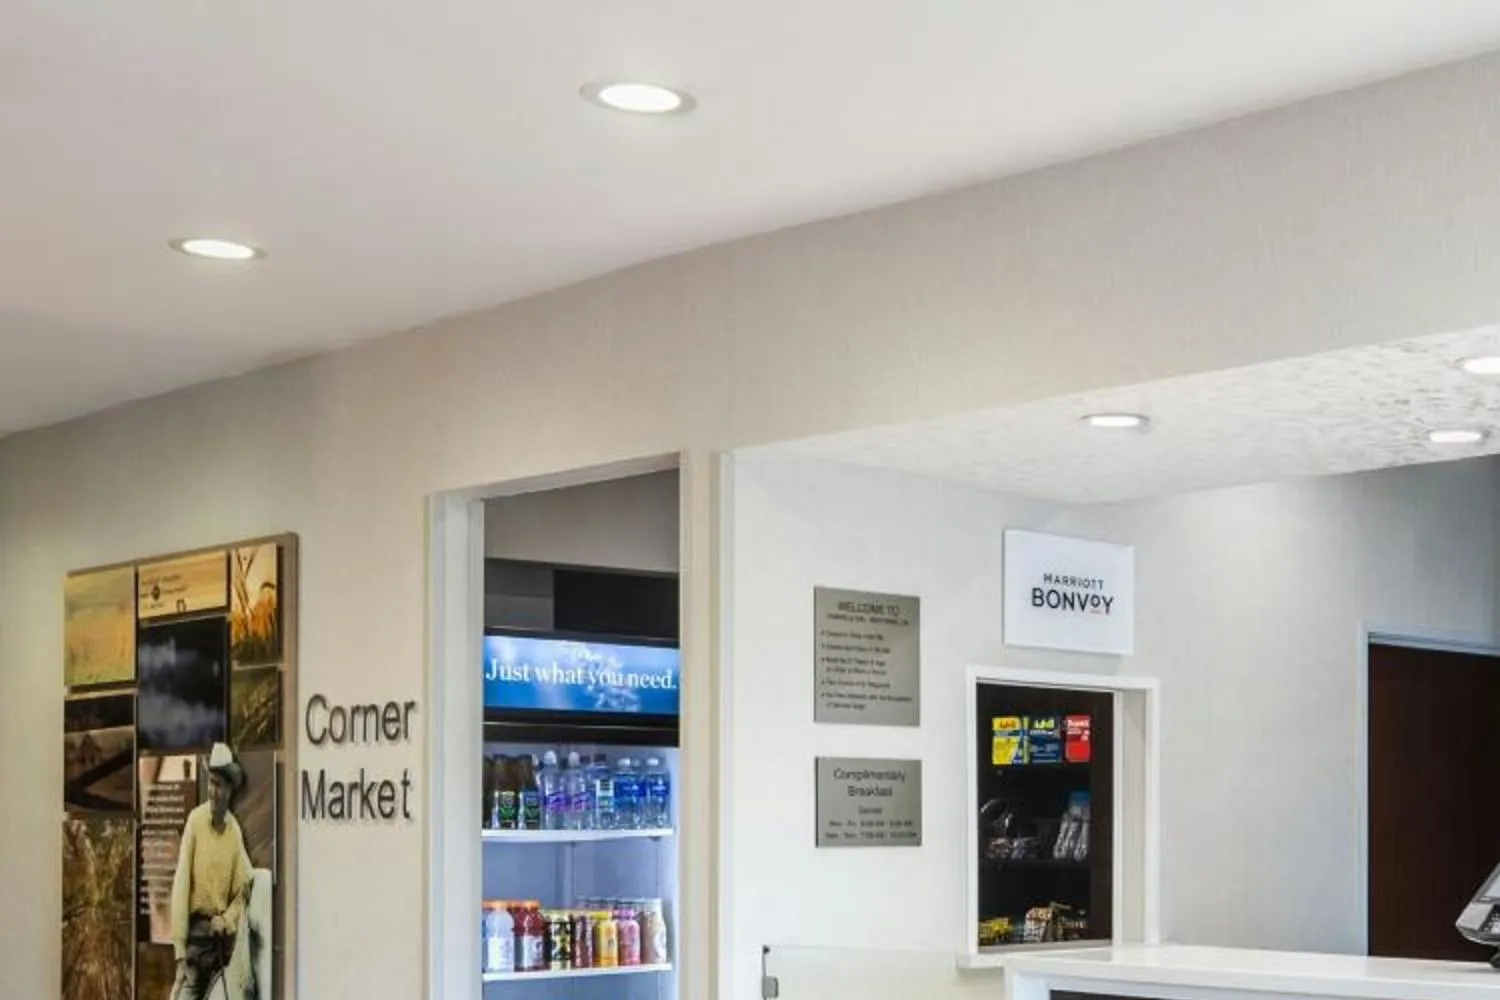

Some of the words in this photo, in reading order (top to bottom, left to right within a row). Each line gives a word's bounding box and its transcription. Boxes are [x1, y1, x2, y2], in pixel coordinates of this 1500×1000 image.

[1043, 573, 1104, 590] MARRIOTT
[486, 658, 530, 681] Just
[534, 662, 582, 685] what
[587, 667, 625, 691] you
[627, 669, 677, 689] need.
[305, 693, 416, 745] Corner
[301, 767, 411, 820] Market
